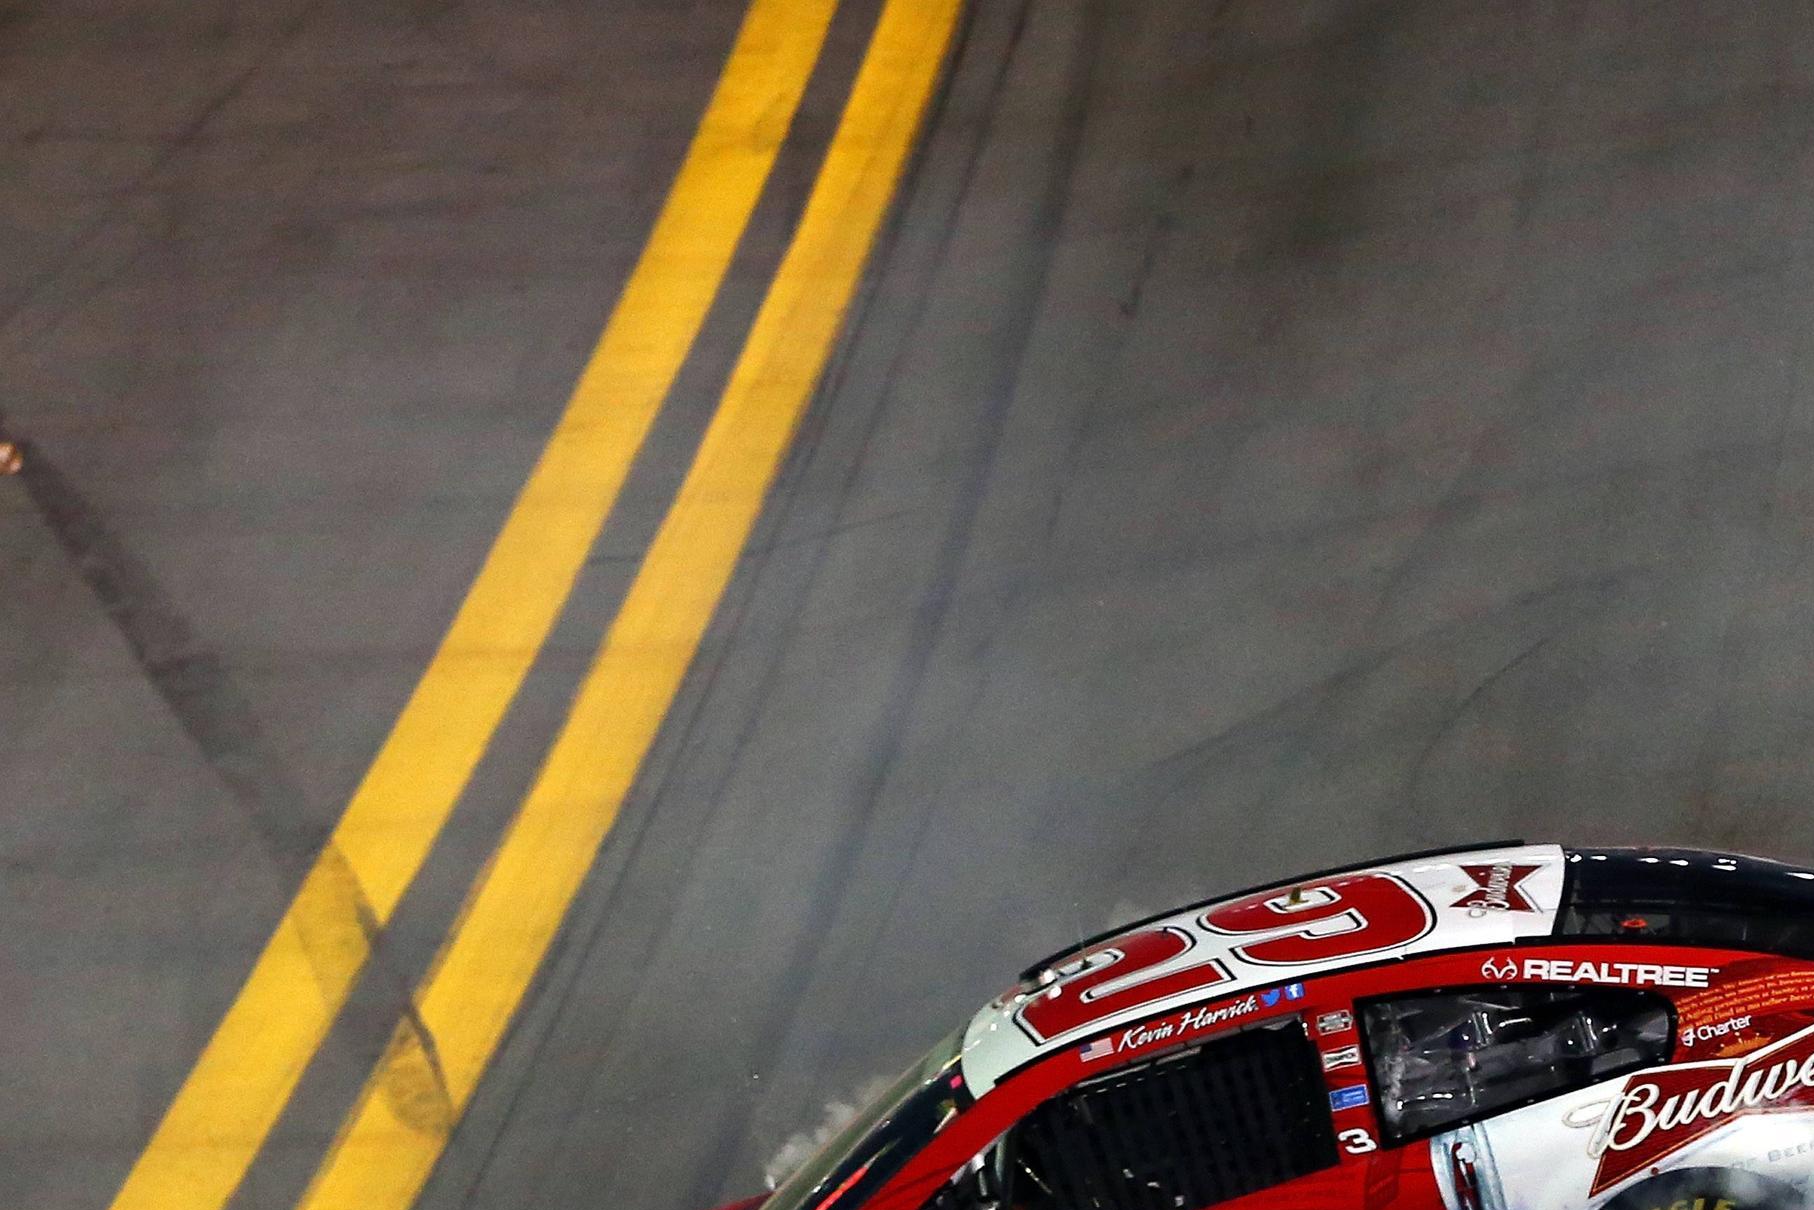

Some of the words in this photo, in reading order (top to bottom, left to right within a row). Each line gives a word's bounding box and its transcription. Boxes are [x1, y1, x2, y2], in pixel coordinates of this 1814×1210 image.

[1013, 872, 1437, 1046] 29
[1523, 959, 1709, 988] REALTREE
[1118, 1022, 1175, 1053] Kevin
[1177, 995, 1257, 1035] Harvick
[1697, 1015, 1752, 1041] Charter
[1338, 1128, 1377, 1154] 3
